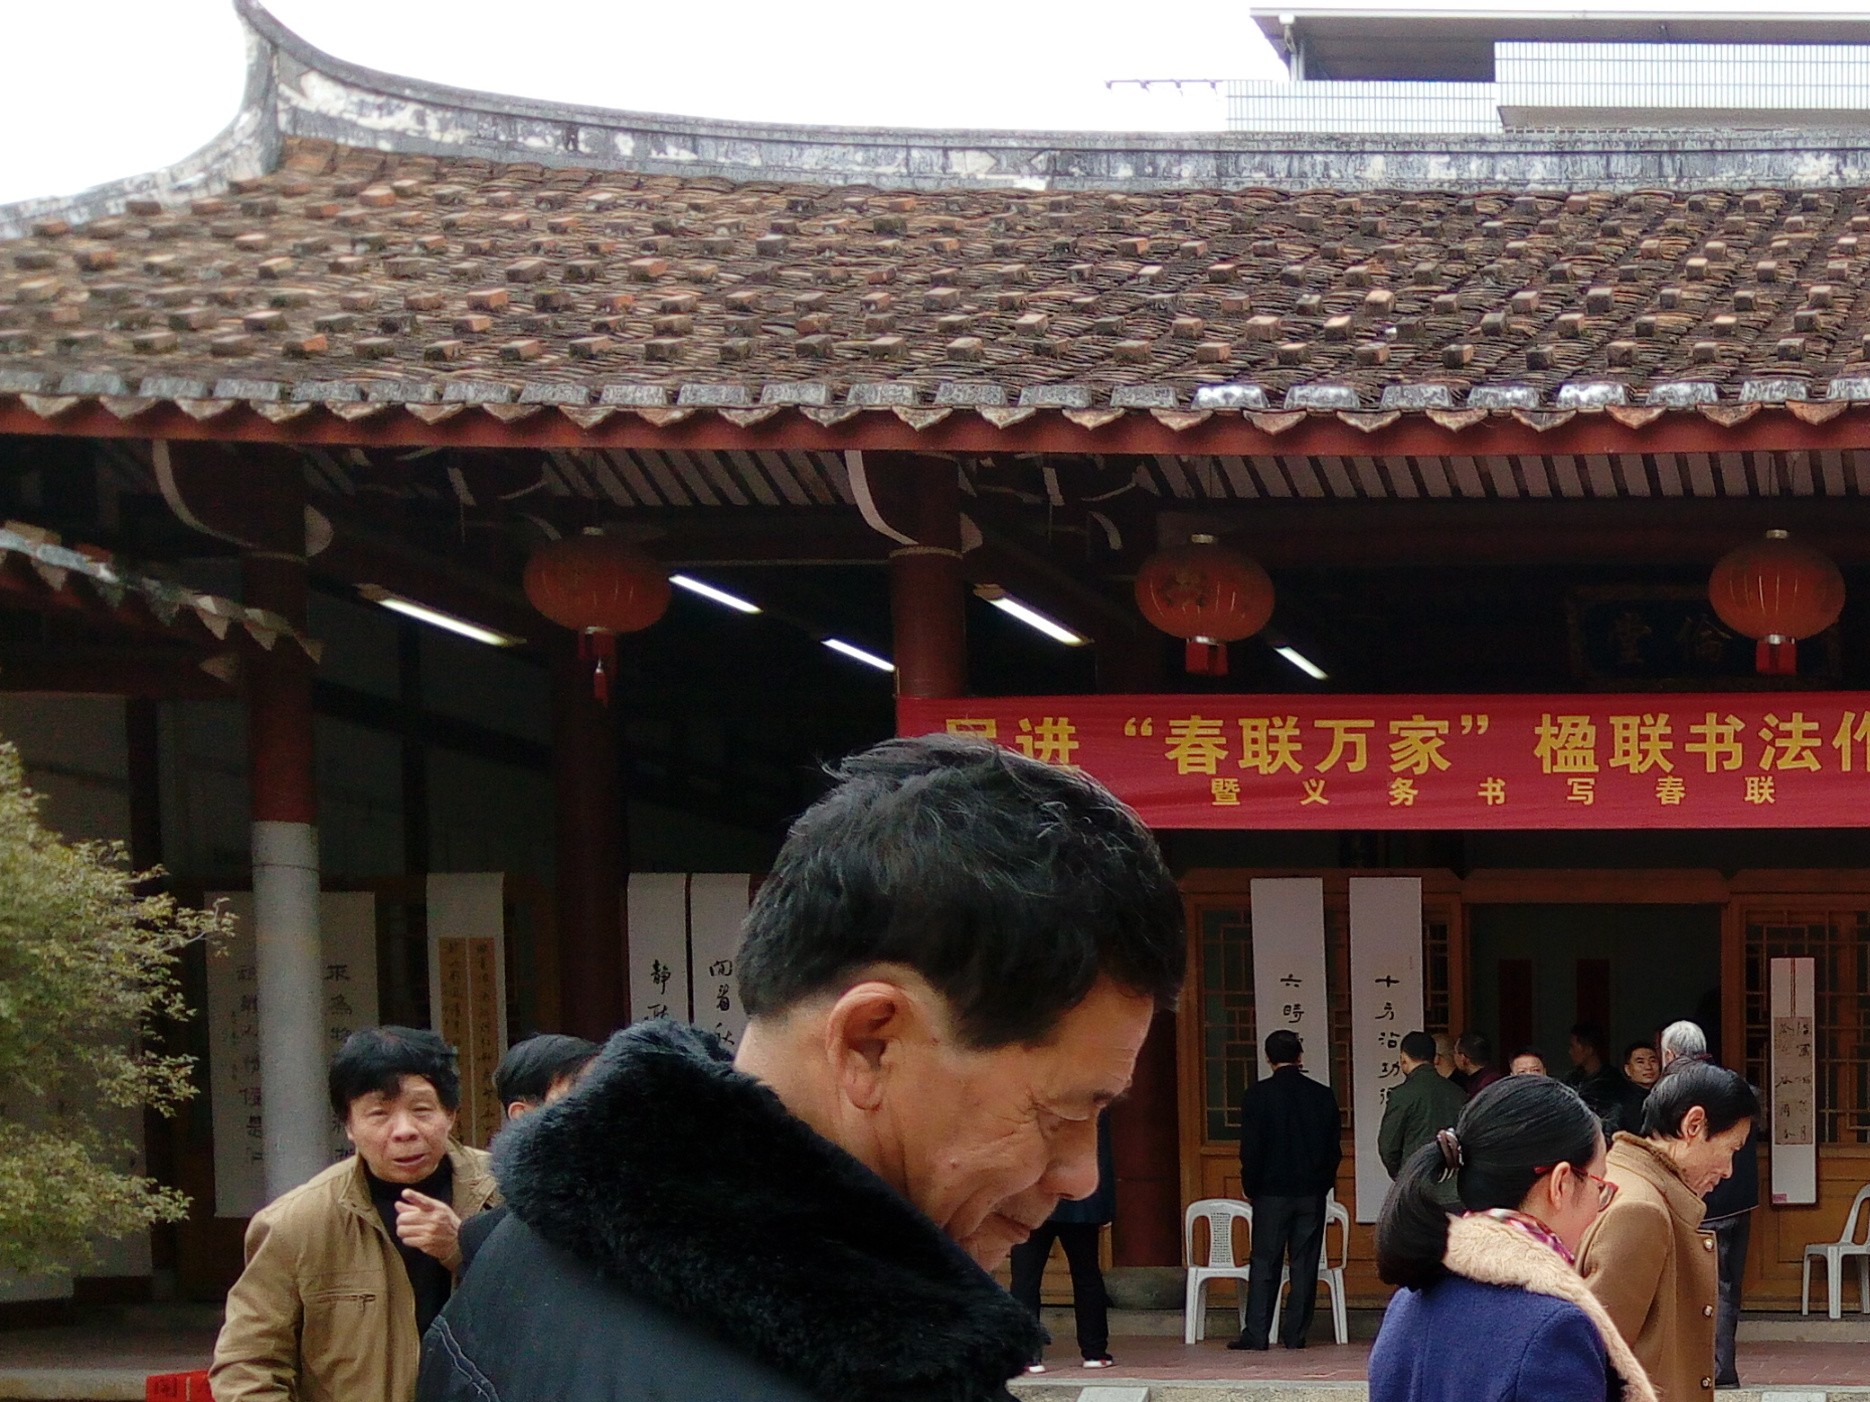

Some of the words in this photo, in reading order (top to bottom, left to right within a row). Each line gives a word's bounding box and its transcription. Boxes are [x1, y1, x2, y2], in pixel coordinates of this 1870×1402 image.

[1211, 776, 1775, 806] 暨义务书写春联
